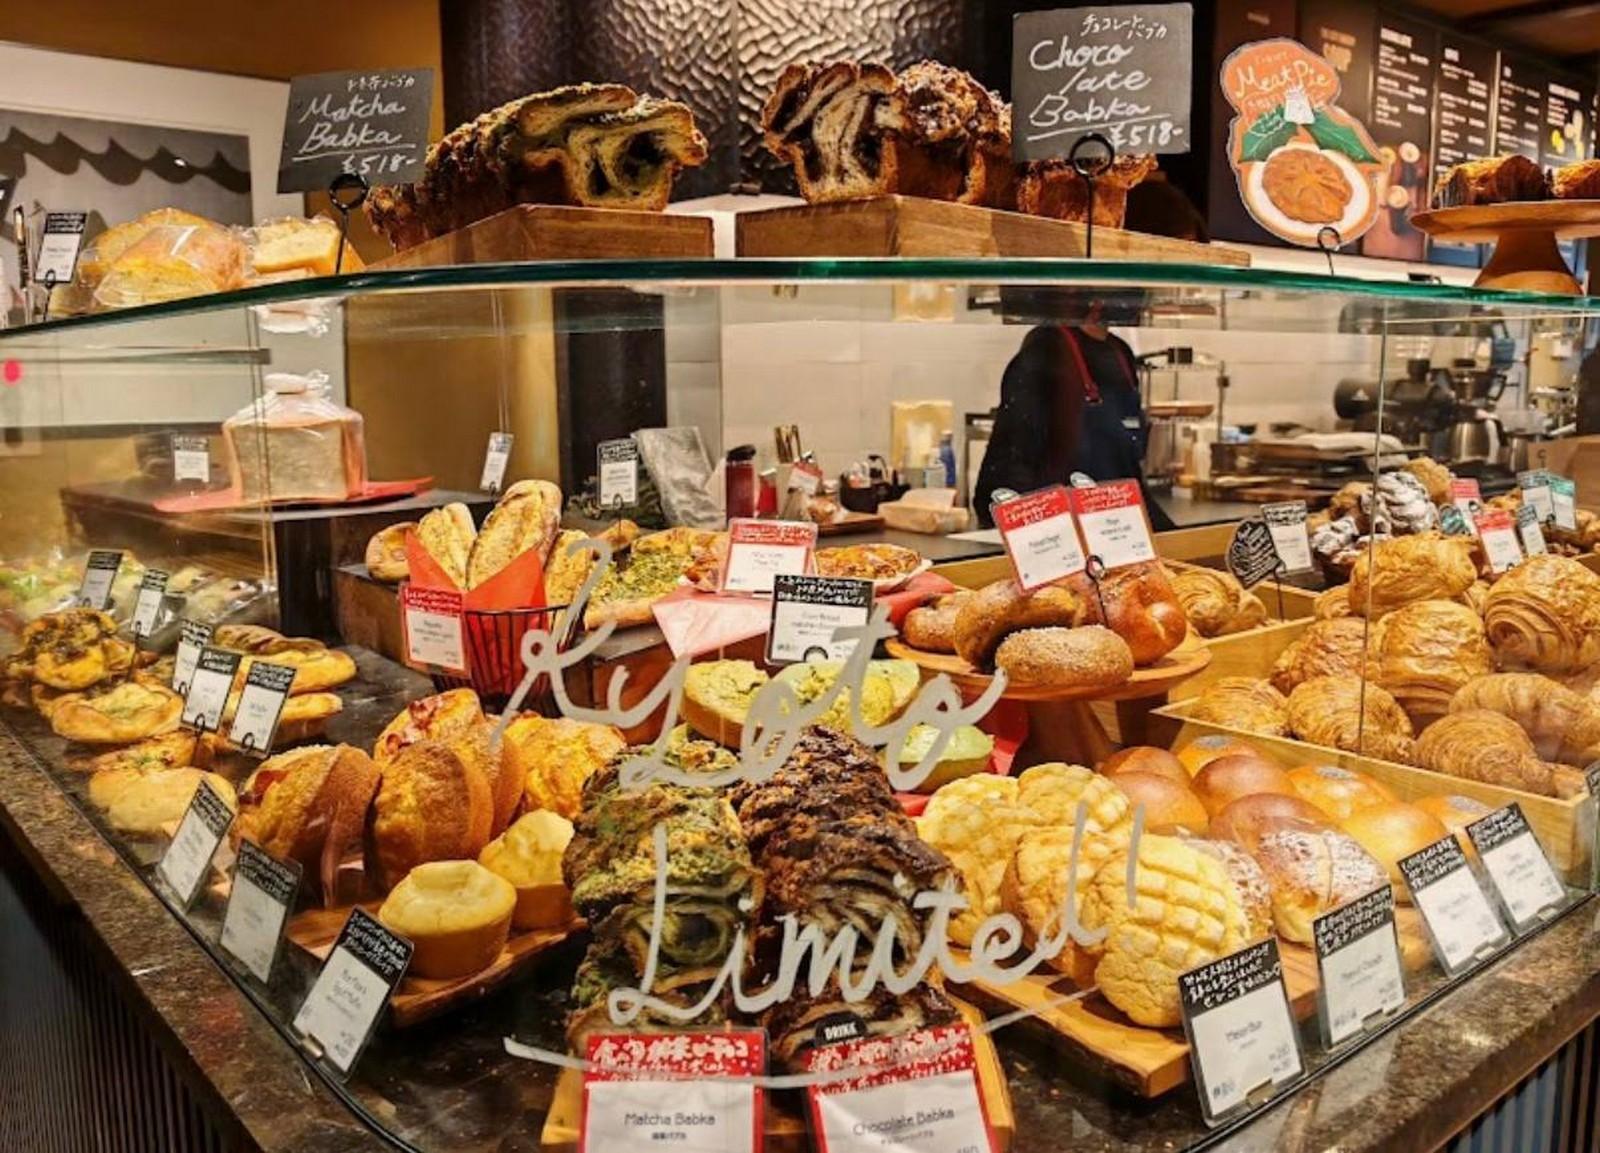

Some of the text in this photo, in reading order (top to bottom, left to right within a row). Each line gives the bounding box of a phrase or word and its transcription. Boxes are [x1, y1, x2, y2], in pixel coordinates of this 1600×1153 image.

[1029, 35, 1135, 71] Choco
[1235, 59, 1330, 99] Meat Pie
[299, 94, 406, 122] Matcha
[1029, 94, 1151, 127] Babka
[299, 122, 402, 154] Babka
[490, 536, 1008, 793] Kyoto
[624, 1111, 716, 1126] Matcha Babka
[916, 1109, 955, 1126] Babka
